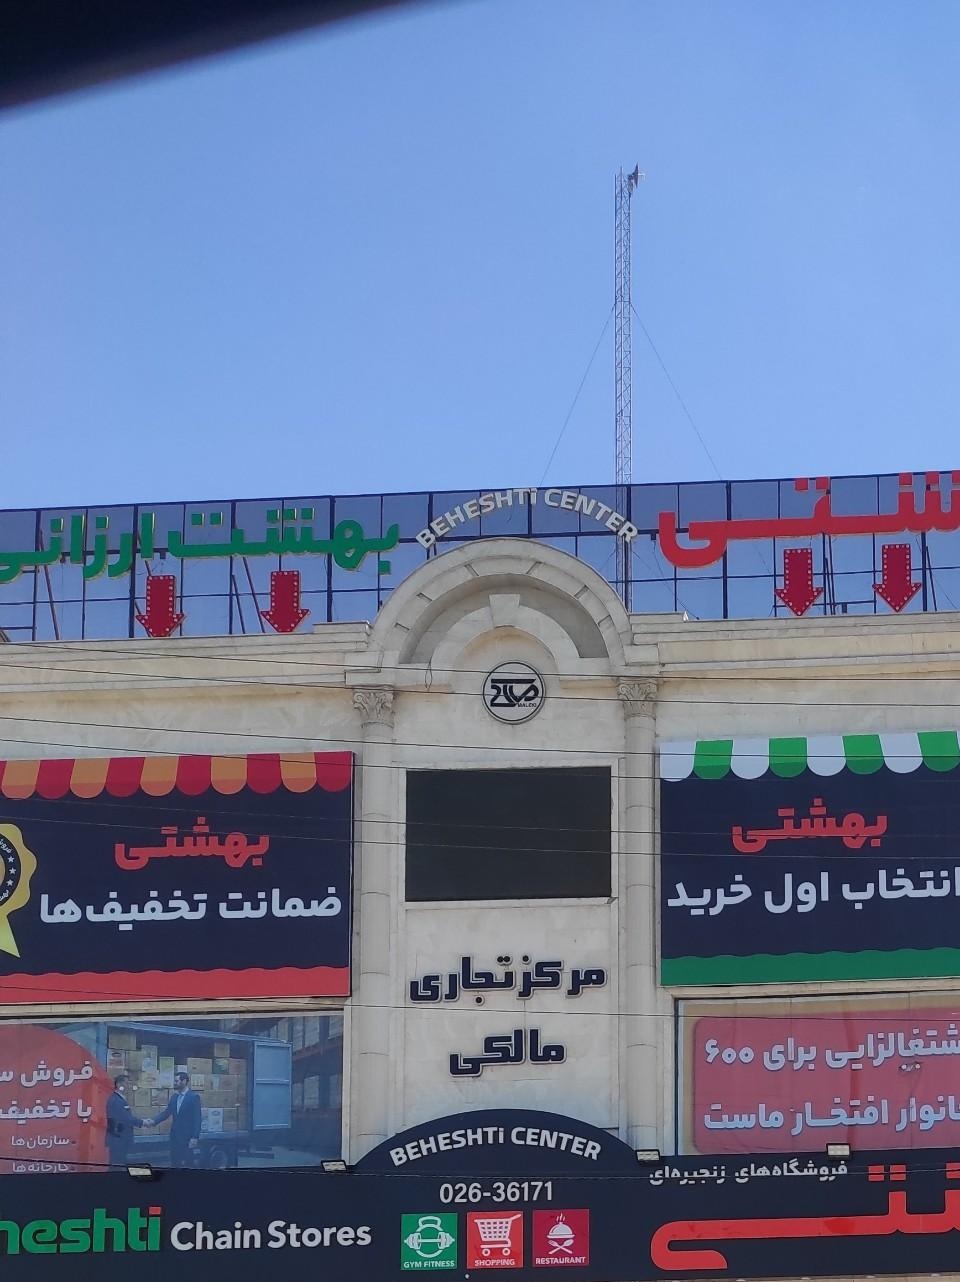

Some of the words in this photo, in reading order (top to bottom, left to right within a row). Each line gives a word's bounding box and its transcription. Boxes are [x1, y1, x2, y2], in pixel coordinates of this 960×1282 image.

[544, 488, 638, 543] CENTER
[168, 507, 399, 575] بهشت
[732, 797, 888, 853] بهشتی
[115, 816, 270, 870] بهشتی
[219, 886, 342, 920] ضمانت
[667, 874, 752, 916] خرید
[763, 869, 829, 915] اول
[409, 955, 514, 1004] تجاری
[516, 954, 606, 999] مرکز
[449, 1028, 566, 1076] مالکی
[763, 1037, 817, 1071] برای
[21, 1060, 93, 1087] فروش
[77, 1099, 92, 1123] با
[703, 1103, 785, 1129] ماست
[791, 1094, 888, 1136] افتخار
[510, 1126, 602, 1160] CENTER
[439, 1181, 553, 1204] 026-36171
[170, 1221, 262, 1251] Chain
[266, 1219, 372, 1248] Stores
[403, 1261, 422, 1269] GYM
[423, 1260, 455, 1268] FITNESS
[474, 1258, 516, 1266] SHOPPING
[535, 1256, 587, 1265] RESTAURANT
